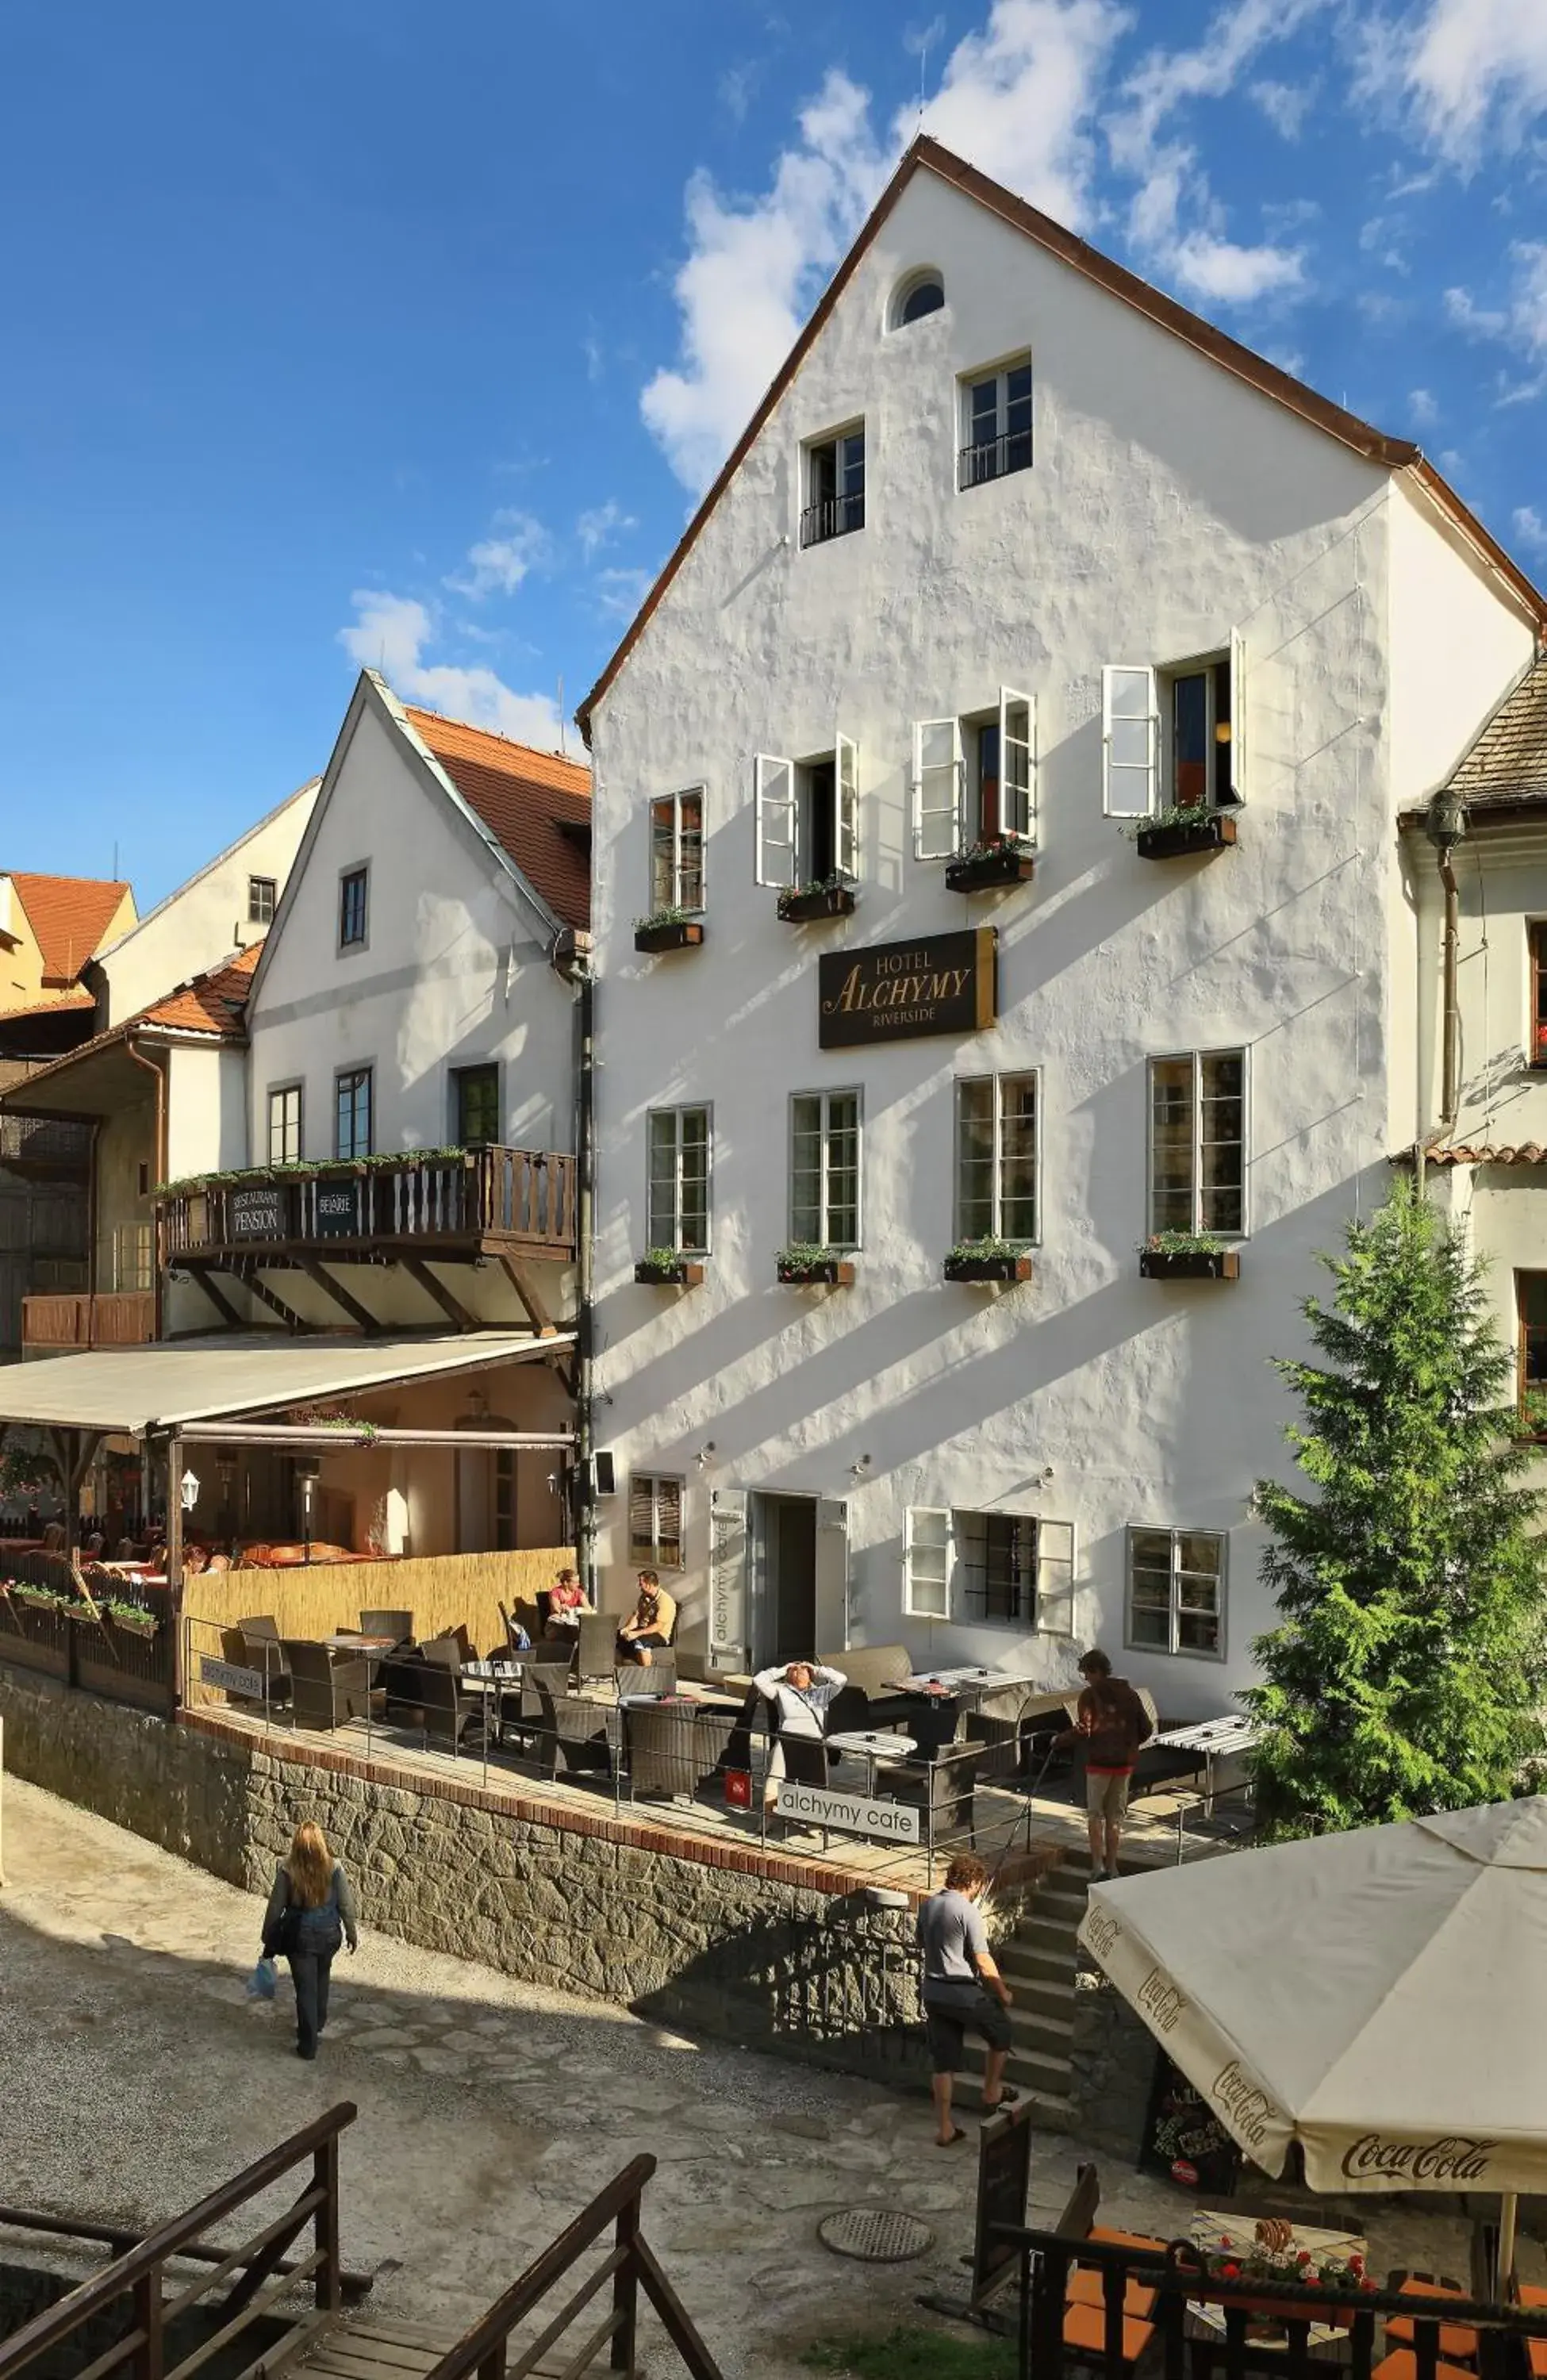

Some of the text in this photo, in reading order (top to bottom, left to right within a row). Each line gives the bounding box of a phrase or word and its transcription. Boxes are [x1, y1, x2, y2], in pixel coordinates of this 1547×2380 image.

[875, 951, 932, 976] HOTEL
[822, 963, 972, 1015] ALCHYMY
[873, 1007, 936, 1027] RIVERSIDE
[234, 1209, 277, 1231] PENSION
[715, 1564, 728, 1641] alchymy
[781, 1792, 912, 1832] alchymy cafe
